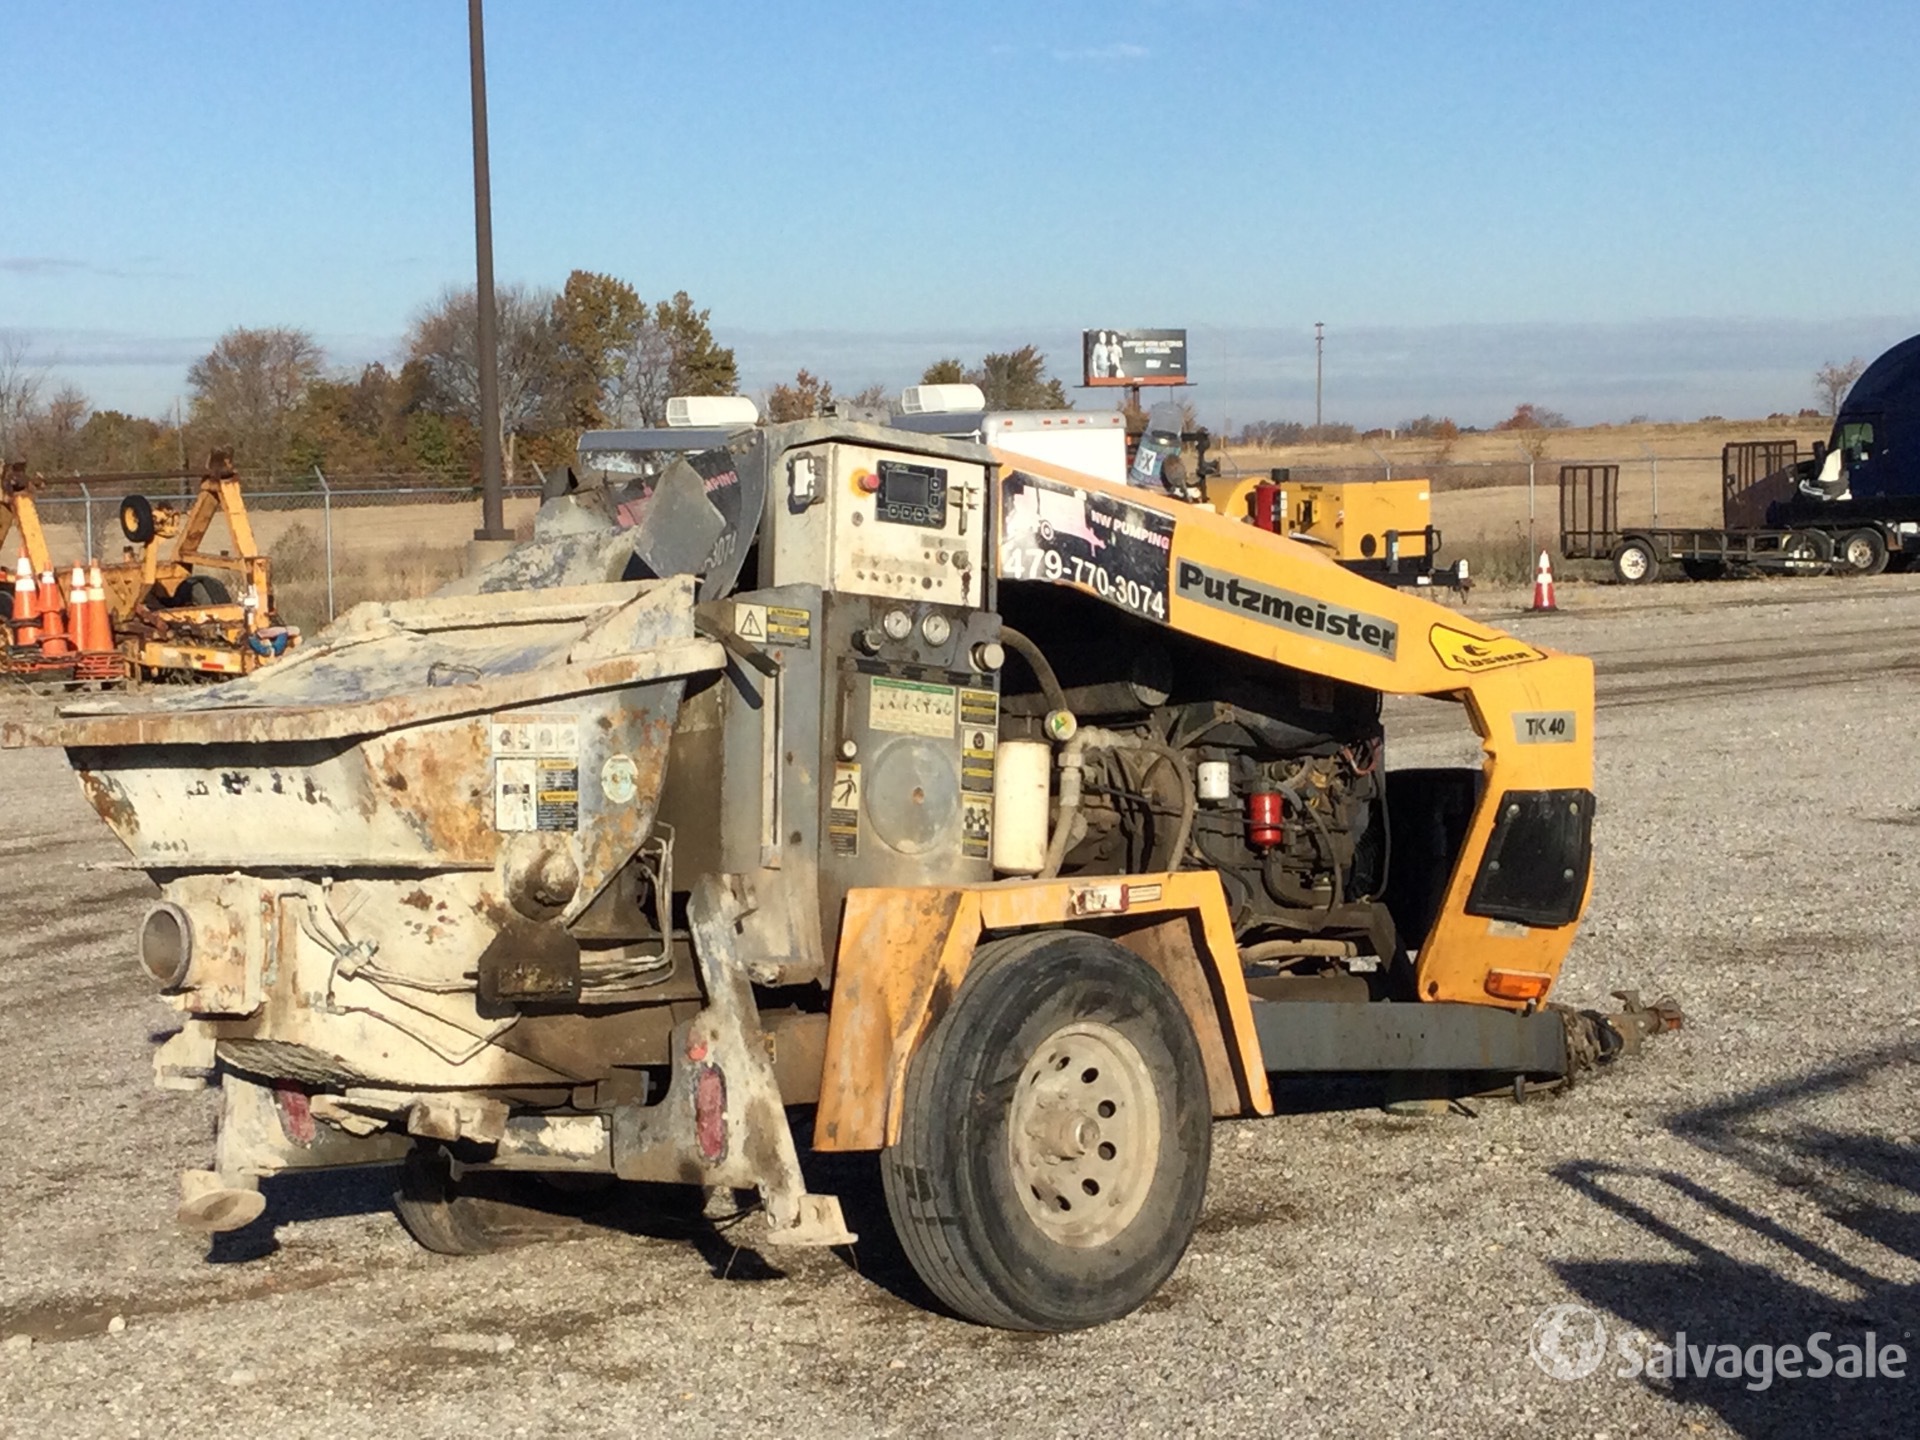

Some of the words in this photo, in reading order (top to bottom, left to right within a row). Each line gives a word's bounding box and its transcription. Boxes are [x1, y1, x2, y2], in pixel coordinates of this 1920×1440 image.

[1091, 510, 1112, 529] NW
[1113, 518, 1170, 550] PUMPING
[1003, 548, 1165, 619] 479-770-3074
[1179, 562, 1395, 650] Putzmeister
[1525, 718, 1546, 736] TK
[1549, 718, 1565, 736] 40
